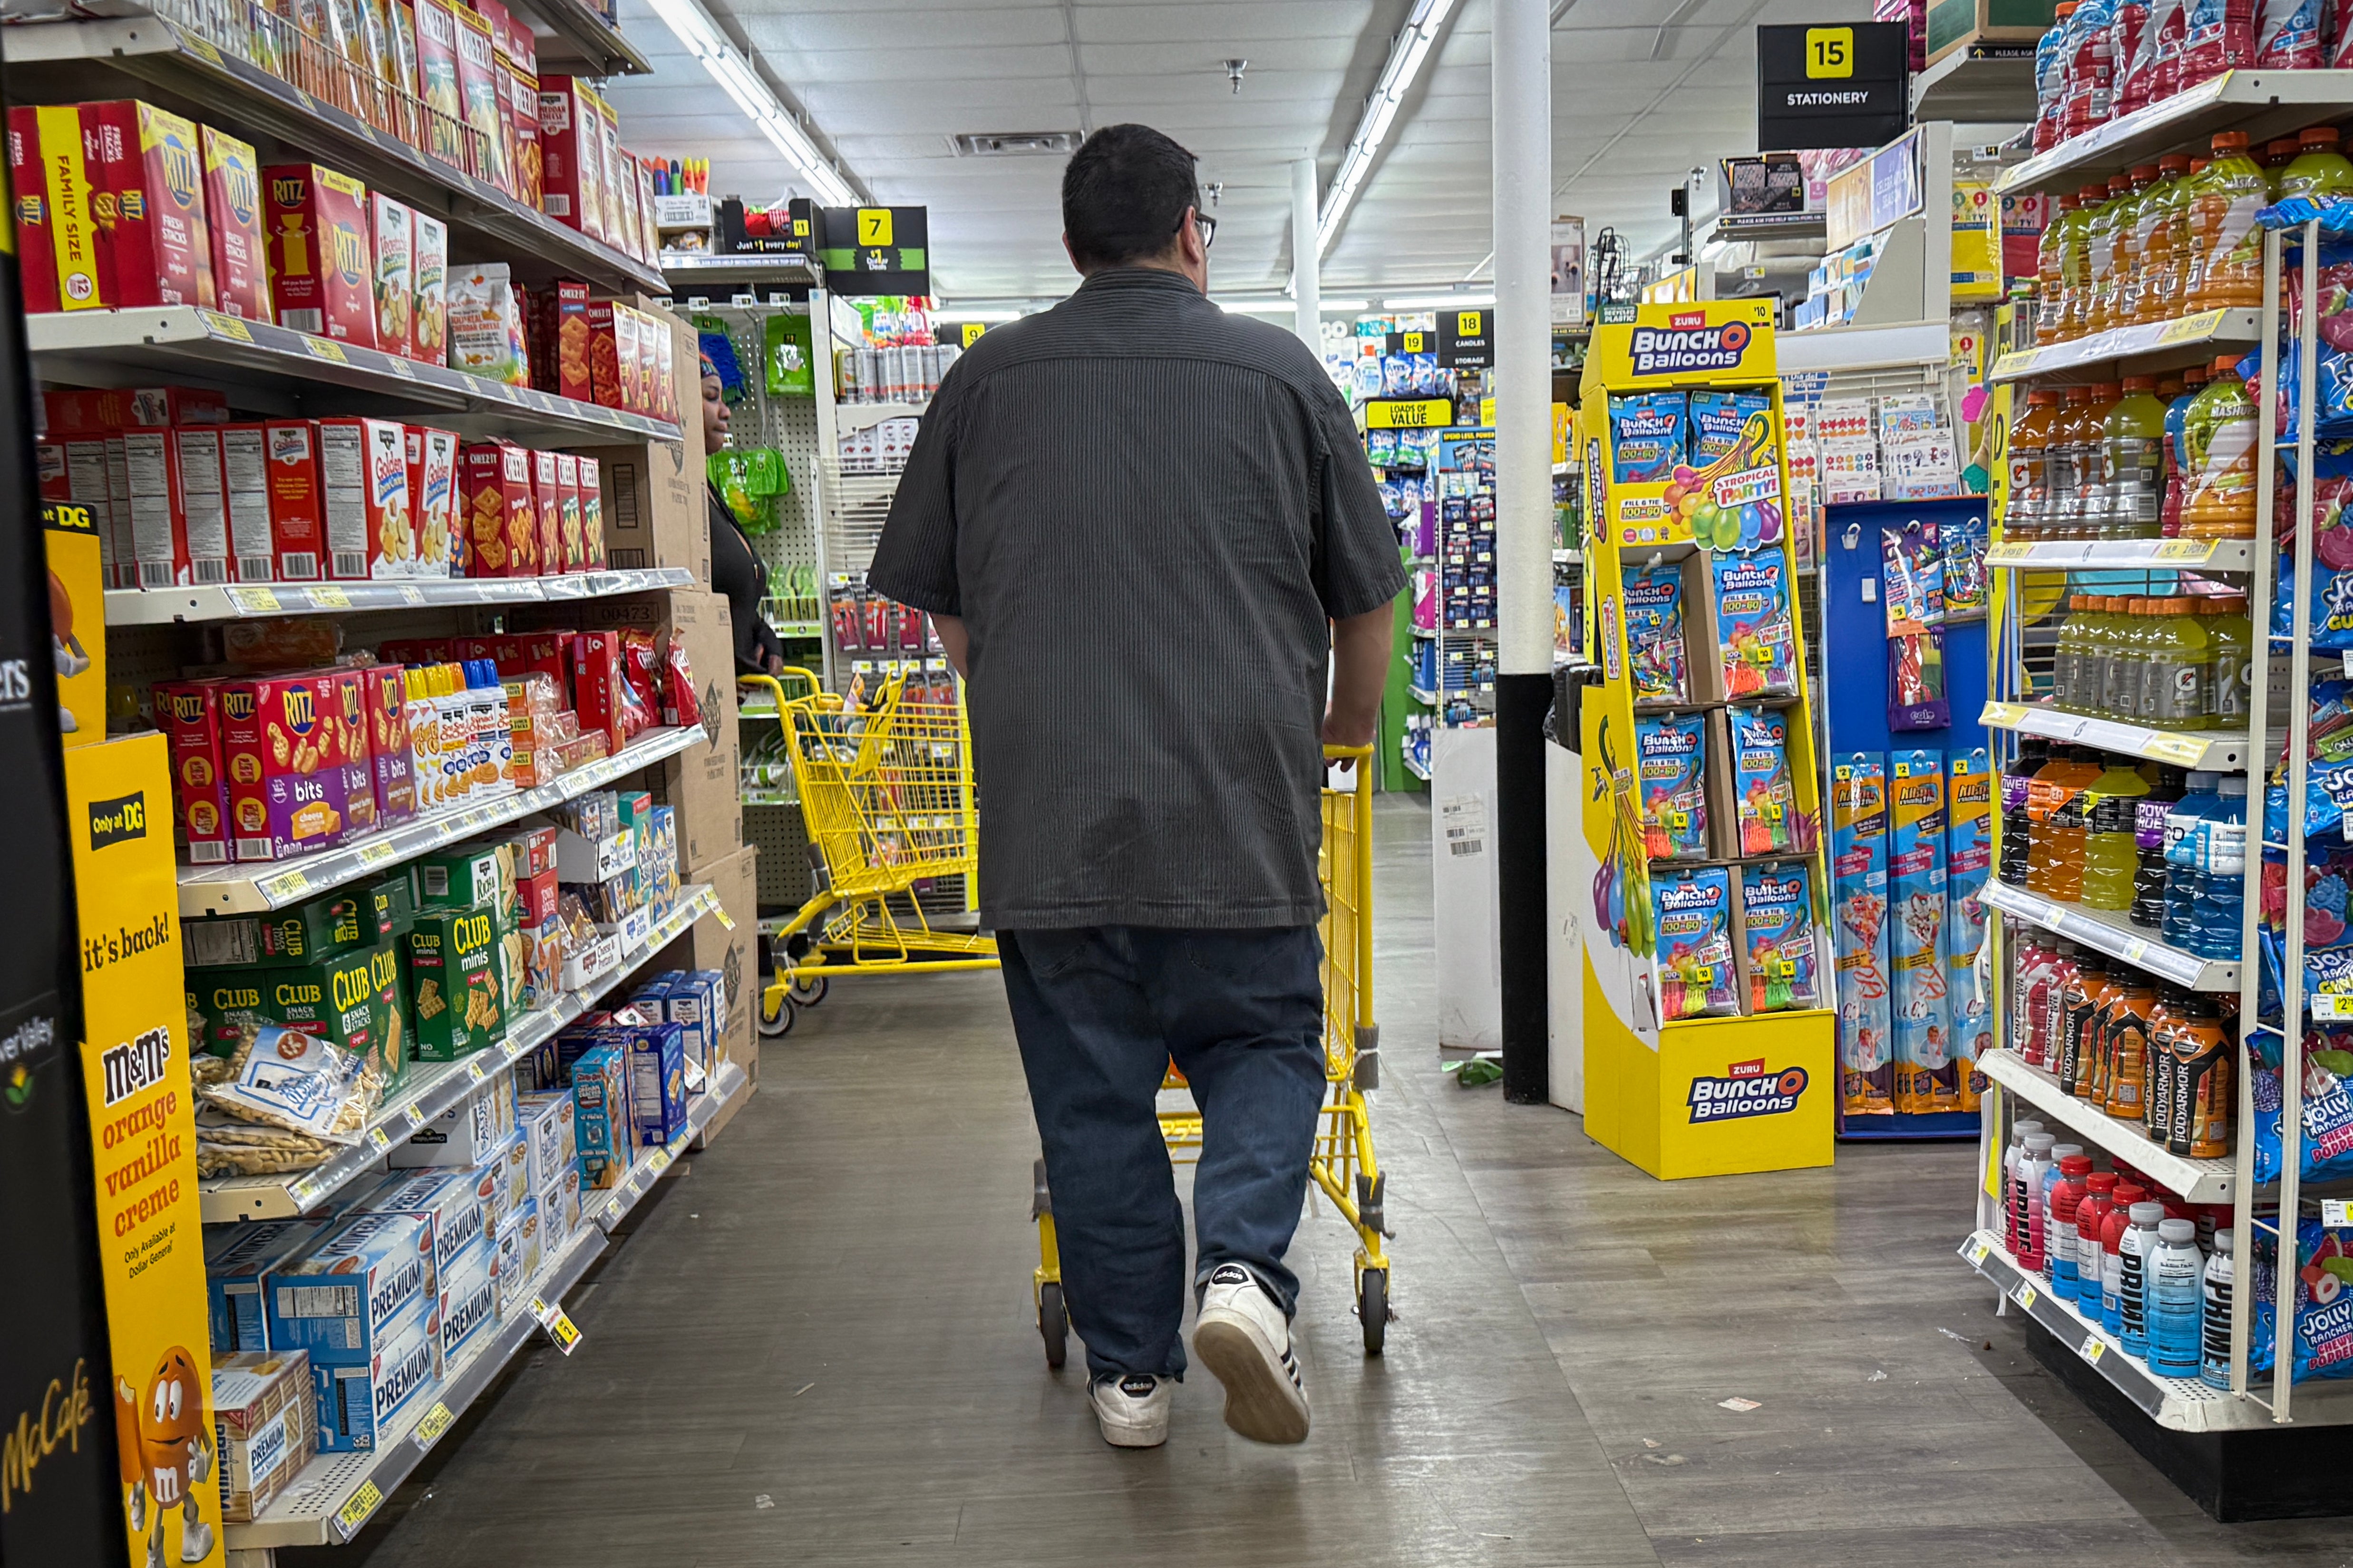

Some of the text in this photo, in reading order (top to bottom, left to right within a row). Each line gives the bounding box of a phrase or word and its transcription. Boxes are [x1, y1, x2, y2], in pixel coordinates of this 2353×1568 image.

[1814, 41, 1844, 66] 15
[1995, 49, 2036, 58] PLEASE ASK
[1787, 91, 1868, 106] STATIONERY
[103, 124, 116, 164] STACKS
[112, 126, 124, 161] FRESH
[162, 145, 194, 196] RITZ
[225, 165, 253, 214] RITZ
[272, 179, 307, 202] RITZ
[21, 195, 42, 226] RITZ
[58, 155, 82, 262] FAMILY SIZE
[122, 190, 144, 222] RITZ
[869, 219, 881, 237] 7
[333, 223, 363, 276] RITZ
[737, 242, 753, 250] Just
[765, 242, 785, 250] every
[786, 239, 802, 250] day!
[78, 278, 90, 294] 12
[1462, 318, 1477, 330] 18
[1674, 317, 1701, 326] ZURU
[1754, 306, 1766, 318] $10
[1408, 337, 1419, 348] 19
[1456, 339, 1485, 348] CANDLES
[1455, 357, 1485, 365] STORAGE
[1638, 351, 1737, 370] Balloons
[1390, 405, 1427, 413] LOADS OF
[1390, 413, 1427, 425] VALUE
[375, 451, 404, 481] Golden
[428, 460, 449, 487] Golden
[1724, 469, 1776, 487] TROPICAL
[2010, 457, 2030, 489] G
[1721, 478, 1777, 505] PARTY!
[57, 505, 91, 528] DG
[2175, 667, 2196, 691] G
[173, 697, 206, 717] RITZ
[223, 692, 256, 714] RITZ
[282, 690, 317, 726] RITZ
[341, 685, 360, 720] RITZ
[381, 678, 399, 714] RITZ
[351, 771, 367, 790] bits
[391, 760, 407, 779] bits
[1898, 765, 1907, 774] $2
[294, 780, 324, 802] bits
[93, 802, 143, 835] Only at DG
[299, 812, 324, 823] cheese
[84, 933, 118, 972] it's
[120, 911, 170, 960] back!
[283, 919, 303, 957] CLUB
[411, 933, 441, 948] CLUB
[454, 914, 492, 955] CLUB
[371, 949, 397, 992] CLUB
[461, 947, 489, 972] minis
[214, 988, 261, 1010] CLUB
[275, 984, 322, 1007] CLUB
[333, 966, 371, 1013] CLUB
[286, 1006, 314, 1014] SNACK
[350, 1004, 369, 1020] SNACK
[351, 1013, 371, 1031] STACKS
[2064, 1012, 2076, 1082] BODYARMOR
[1734, 1065, 1760, 1075] ZURU
[2155, 1054, 2170, 1130] BODYARMOR
[2175, 1064, 2189, 1143] BODYARMOR
[103, 1091, 177, 1150] orange
[1695, 1096, 1793, 1118] Balloons
[2302, 1094, 2353, 1128] JOLLY
[104, 1133, 182, 1198] vanilla
[114, 1178, 180, 1238] creme
[2016, 1181, 2032, 1254] PRIME
[125, 1247, 139, 1263] Only
[141, 1228, 168, 1254] Available
[437, 1202, 481, 1266] PREMIUM
[129, 1239, 173, 1279] Dollar General
[1214, 1269, 1243, 1281] adidas
[371, 1259, 421, 1326] PREMIUM
[2119, 1252, 2146, 1338] PRIME
[443, 1283, 492, 1349] PREMIUM
[2204, 1277, 2233, 1367] PRIME
[2303, 1303, 2351, 1336] JOLLY
[376, 1341, 431, 1417] PREMIUM
[1124, 1381, 1153, 1391] adidas
[1, 1357, 94, 1514] McCafé
[251, 1422, 285, 1467] PREMIUM
[215, 1424, 231, 1510] PREMIUM
